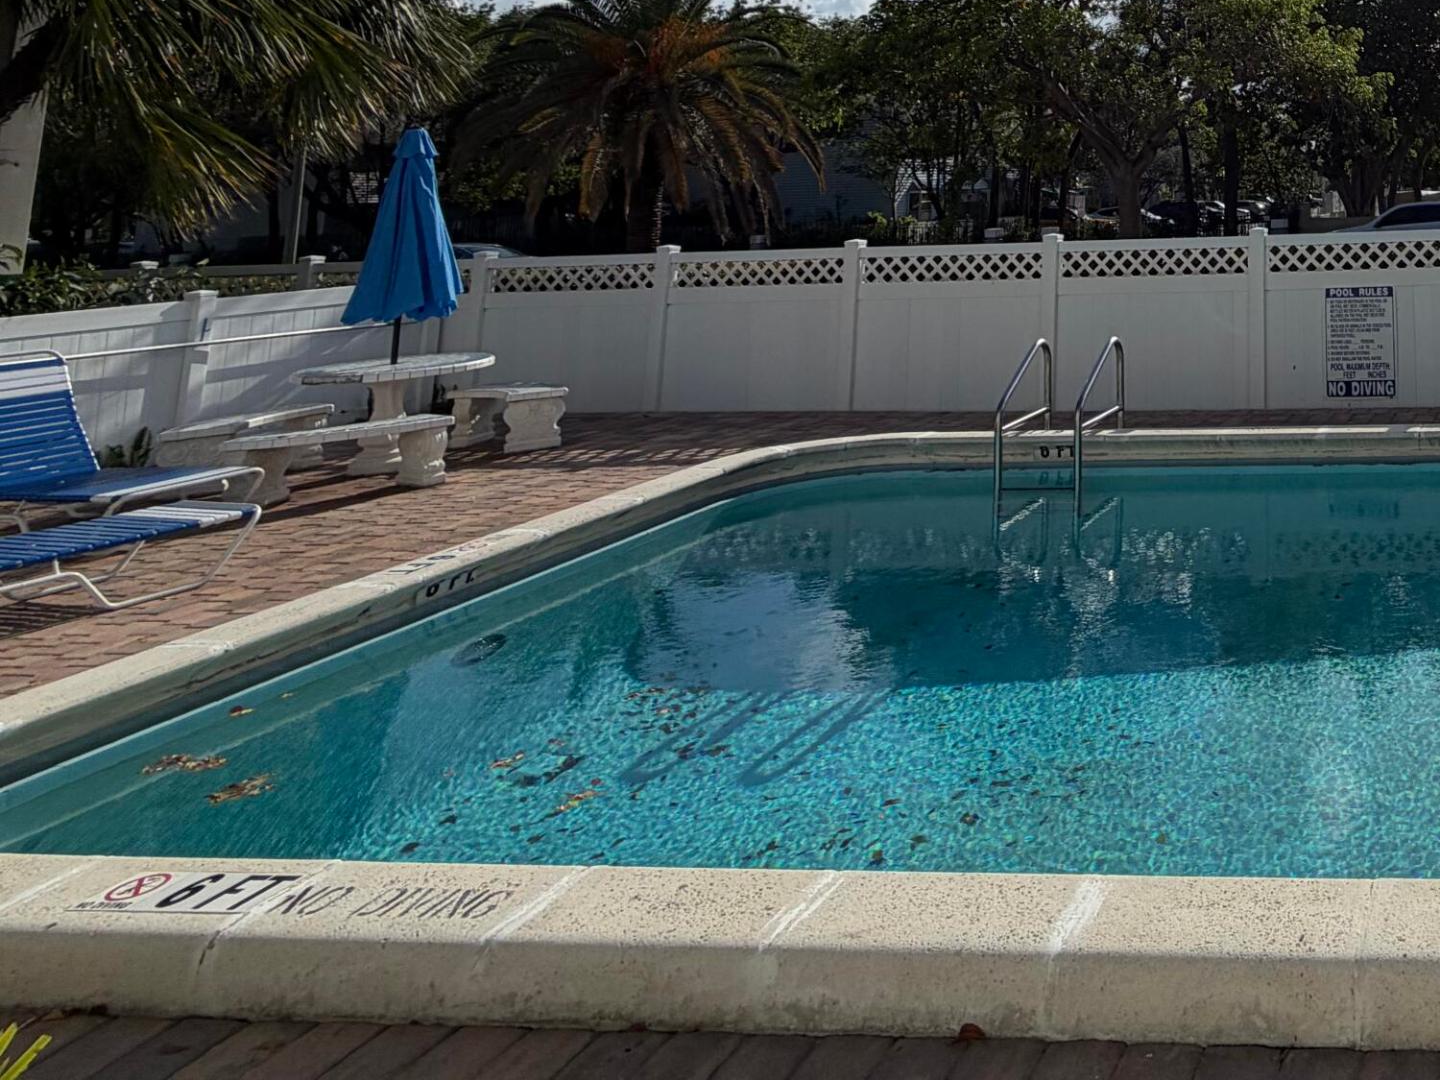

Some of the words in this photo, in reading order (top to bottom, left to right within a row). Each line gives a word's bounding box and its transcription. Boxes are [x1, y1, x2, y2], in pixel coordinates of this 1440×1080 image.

[1329, 288, 1354, 297] POOL
[1358, 287, 1389, 296] RULES
[1346, 362, 1371, 371] MAXIMUM
[1343, 371, 1356, 379] FEET
[1328, 381, 1346, 396] NO
[1351, 380, 1394, 396] DIVING
[154, 873, 225, 908] 6
[192, 874, 302, 911] FT
[268, 885, 354, 916] NO
[350, 887, 514, 920] DIVING
